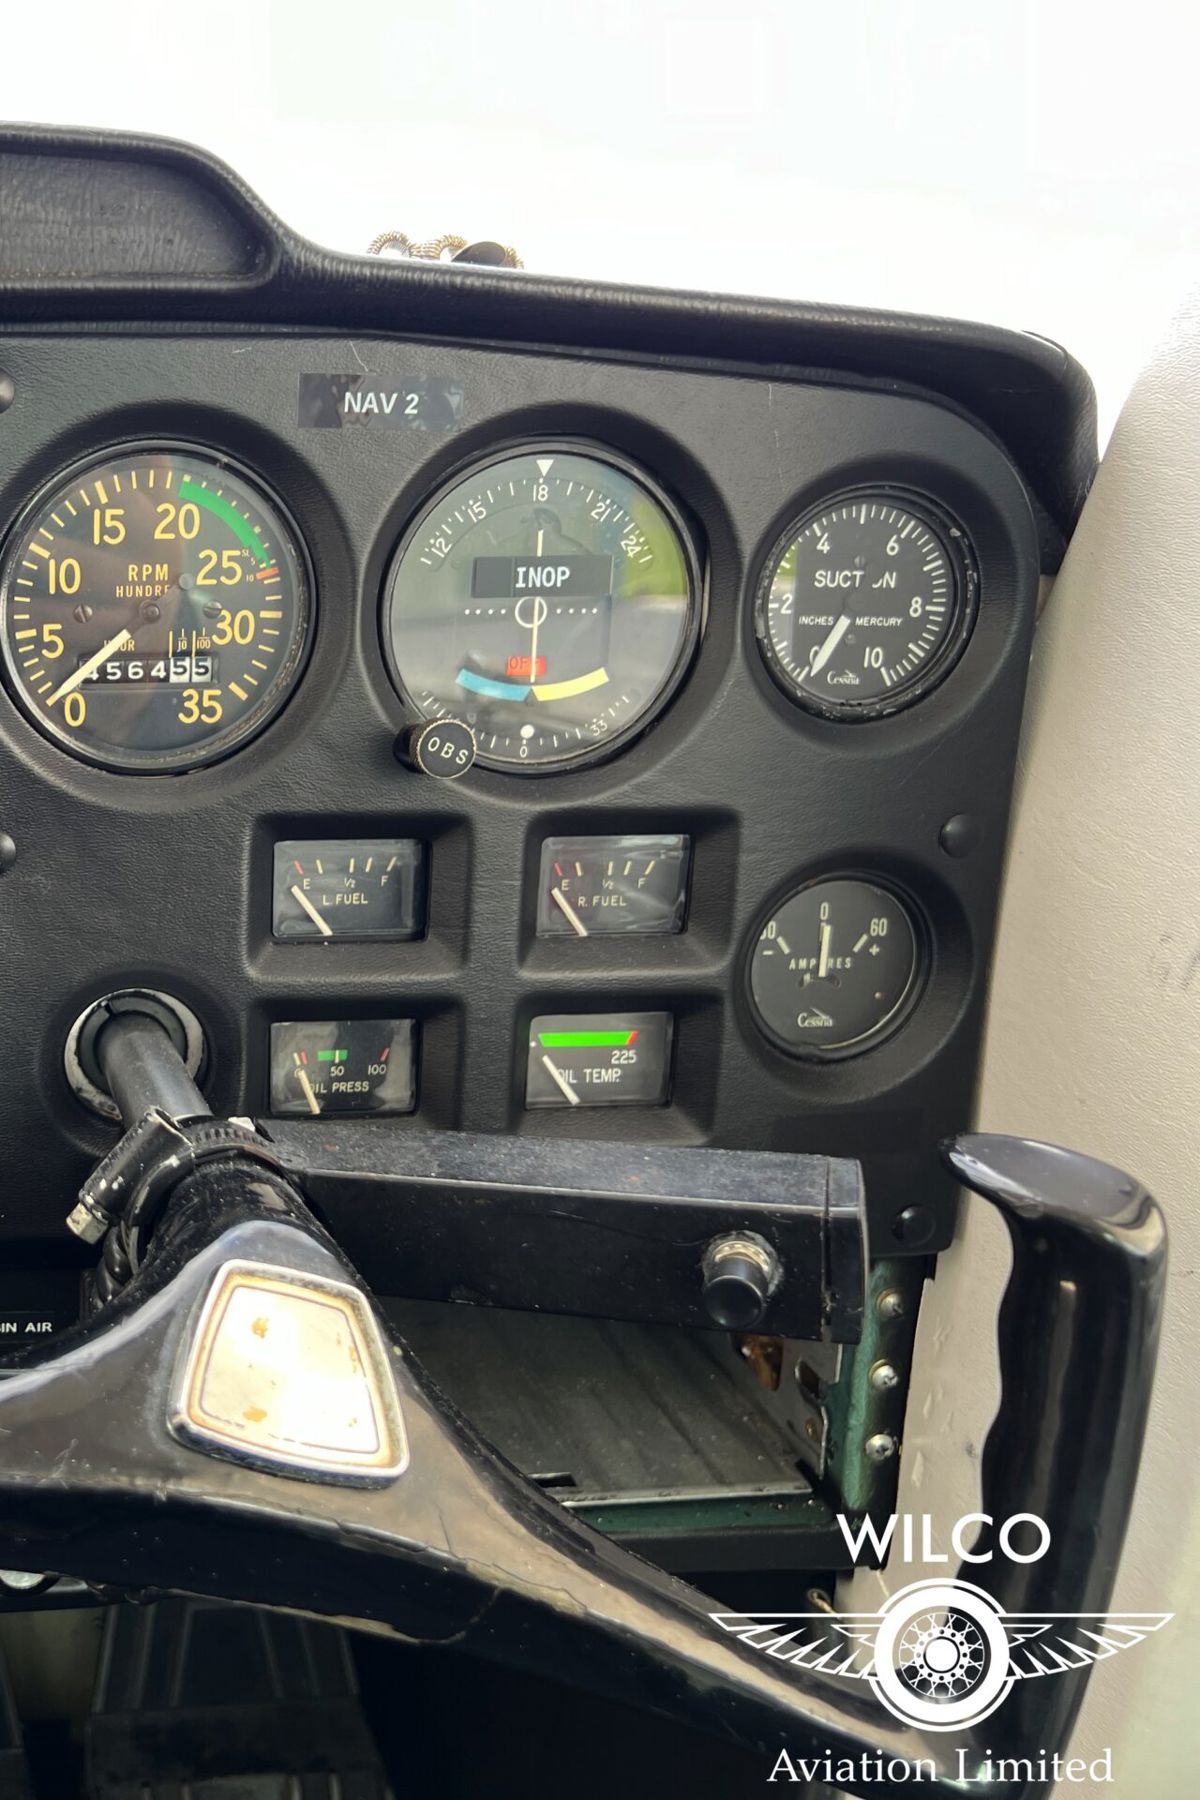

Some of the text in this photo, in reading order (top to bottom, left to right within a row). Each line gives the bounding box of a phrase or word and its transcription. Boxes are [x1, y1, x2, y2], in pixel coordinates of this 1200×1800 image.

[344, 392, 419, 414] NAV 2
[533, 484, 548, 502] 18
[154, 503, 200, 540] 20
[468, 502, 486, 522] 15
[591, 502, 608, 522] 21
[93, 508, 126, 544] 15
[431, 538, 452, 558] 12
[620, 535, 642, 558] 24
[49, 558, 81, 594] 10
[128, 564, 168, 582] RPM
[196, 549, 242, 586] 25
[514, 566, 570, 588] INOP
[212, 609, 255, 645] 30
[798, 616, 834, 626] INCHES
[856, 616, 903, 627] MERCURY
[864, 646, 884, 668] 10
[178, 688, 222, 724] 35
[428, 736, 468, 765] OBS
[336, 892, 368, 905] FUEL
[592, 896, 627, 907] FUEL
[870, 918, 888, 936] 60
[797, 1012, 833, 1028] Cessna
[611, 1049, 637, 1064] 225
[330, 1065, 345, 1077] 50
[367, 1064, 387, 1075] 100
[332, 1081, 370, 1092] PRESS
[24, 1322, 52, 1334] AIR
